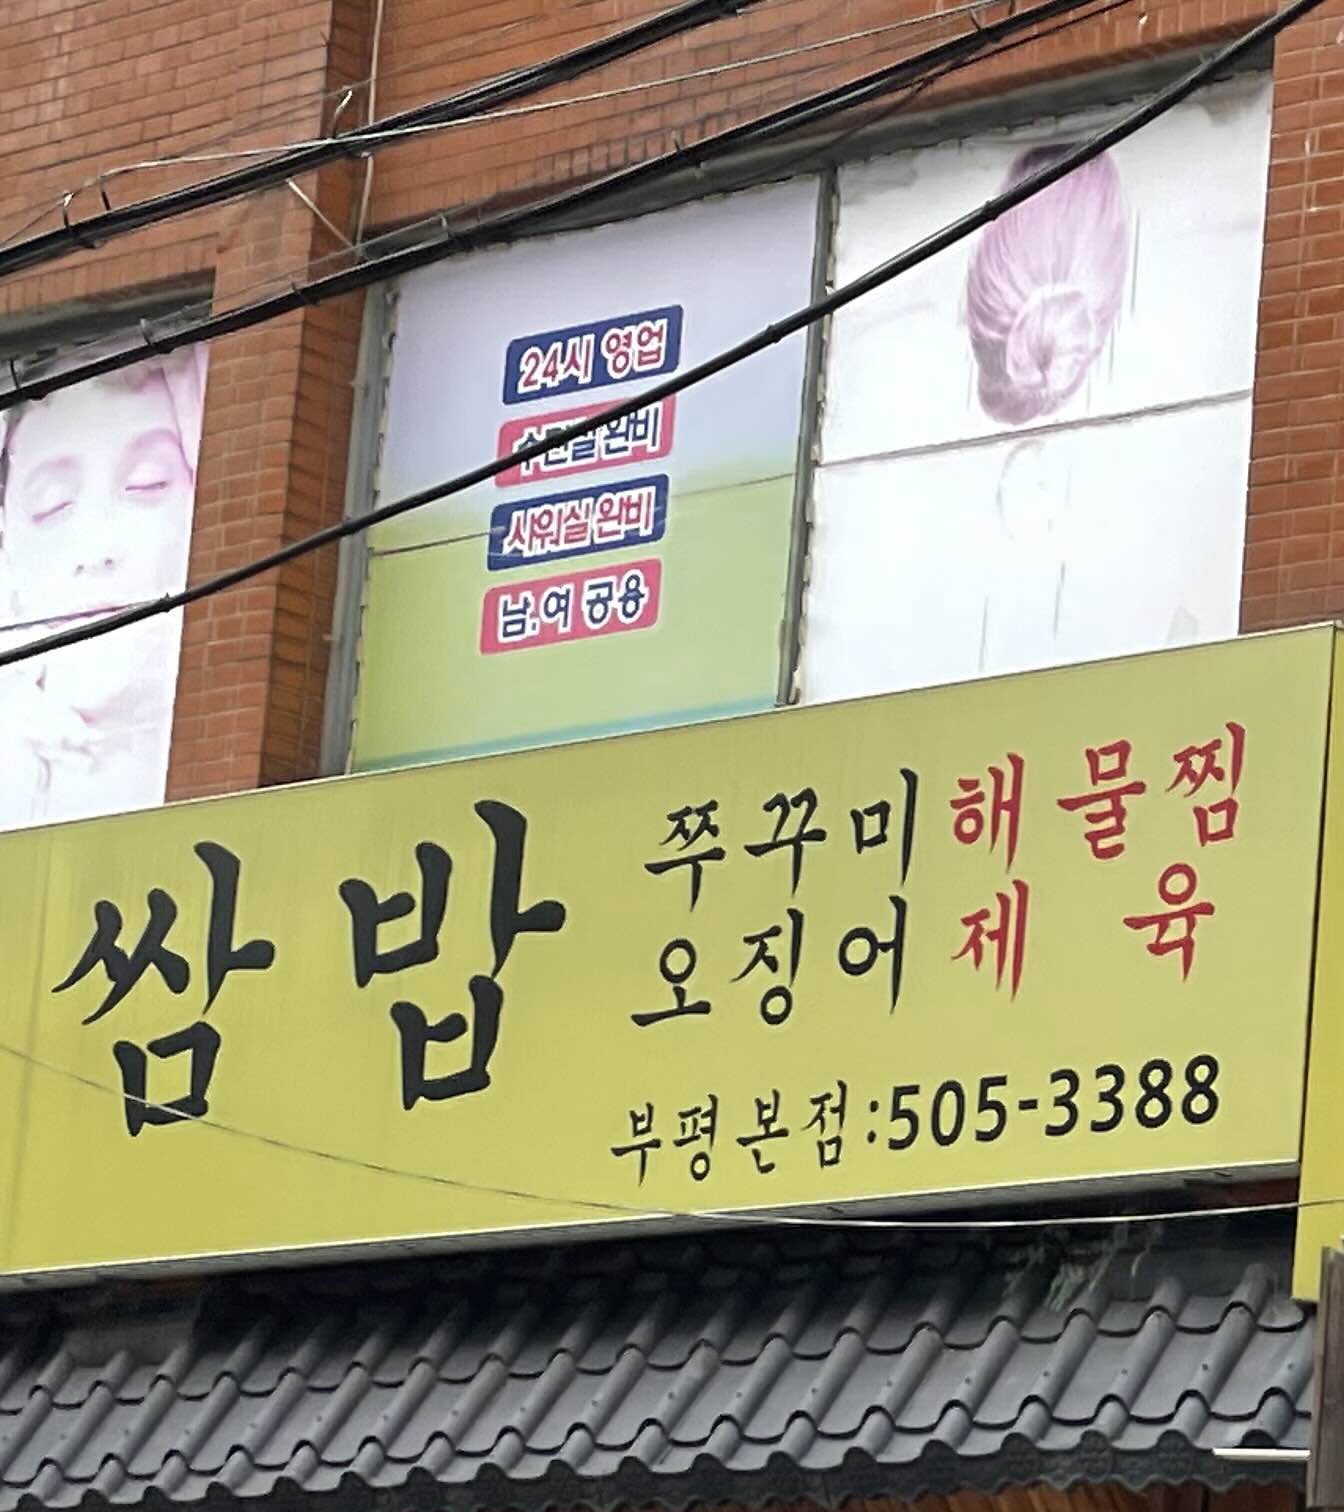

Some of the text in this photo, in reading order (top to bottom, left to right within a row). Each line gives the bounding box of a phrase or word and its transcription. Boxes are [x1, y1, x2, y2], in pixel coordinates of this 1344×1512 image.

[520, 321, 665, 386] 24시 영업
[598, 492, 654, 540] 완비
[502, 577, 646, 638] 남.여 공용
[643, 720, 1247, 912] 쭈꾸미 해물찜
[630, 894, 908, 1029] 오징어
